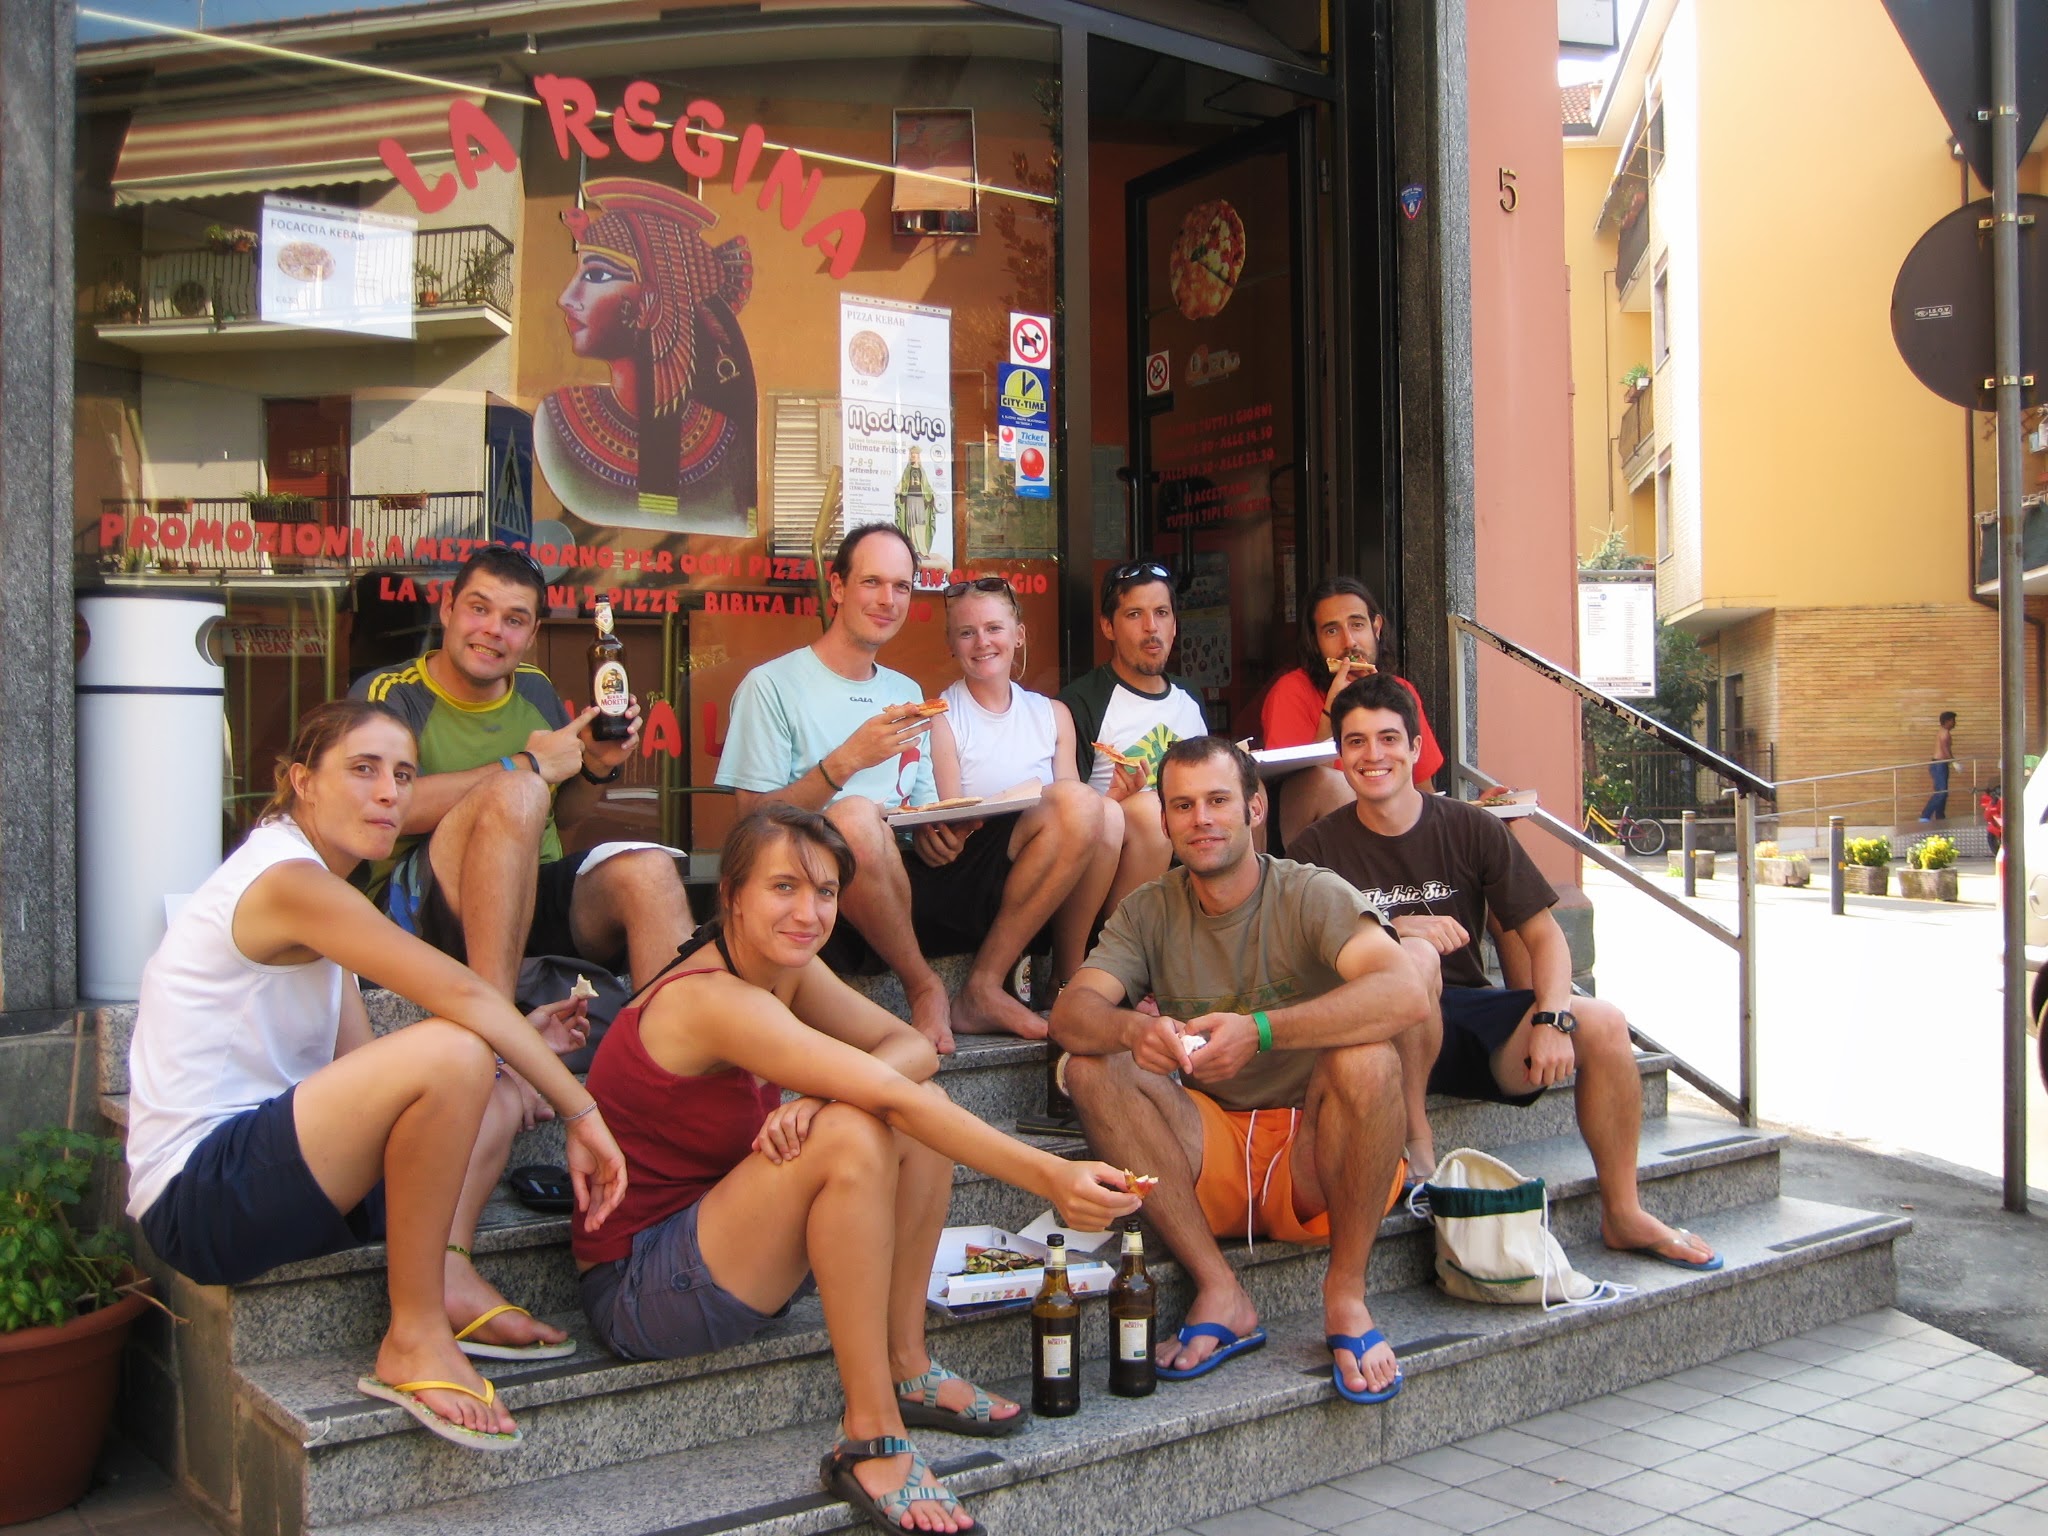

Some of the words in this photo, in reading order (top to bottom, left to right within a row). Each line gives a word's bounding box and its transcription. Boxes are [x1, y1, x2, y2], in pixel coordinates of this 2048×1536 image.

[379, 99, 517, 214] LA
[534, 74, 866, 279] REGINA
[1499, 167, 1519, 213] 5
[271, 218, 326, 236] FOCACCIA
[329, 227, 365, 241] KEBAB
[847, 310, 873, 322] PIZZA
[875, 314, 906, 327] KEBAB
[1236, 402, 1273, 424] GIORNI
[848, 404, 945, 442] Madunina
[1021, 431, 1044, 442] Ticket
[848, 442, 881, 453] Ultimate
[882, 445, 907, 455] Frisbee
[849, 457, 874, 468] 7-8-9
[849, 465, 879, 475] settembre
[100, 512, 375, 559] PROMOZIONI:
[385, 535, 416, 559] A
[622, 548, 674, 574] PER
[680, 554, 741, 577] OGNI
[748, 556, 818, 580] PIZZA
[380, 576, 417, 602] LA
[606, 588, 680, 613] PIZZE
[704, 591, 787, 617] BIBITA
[794, 596, 819, 617] IN
[849, 696, 874, 704] GAIA
[970, 1287, 1028, 1303] PIZZA
